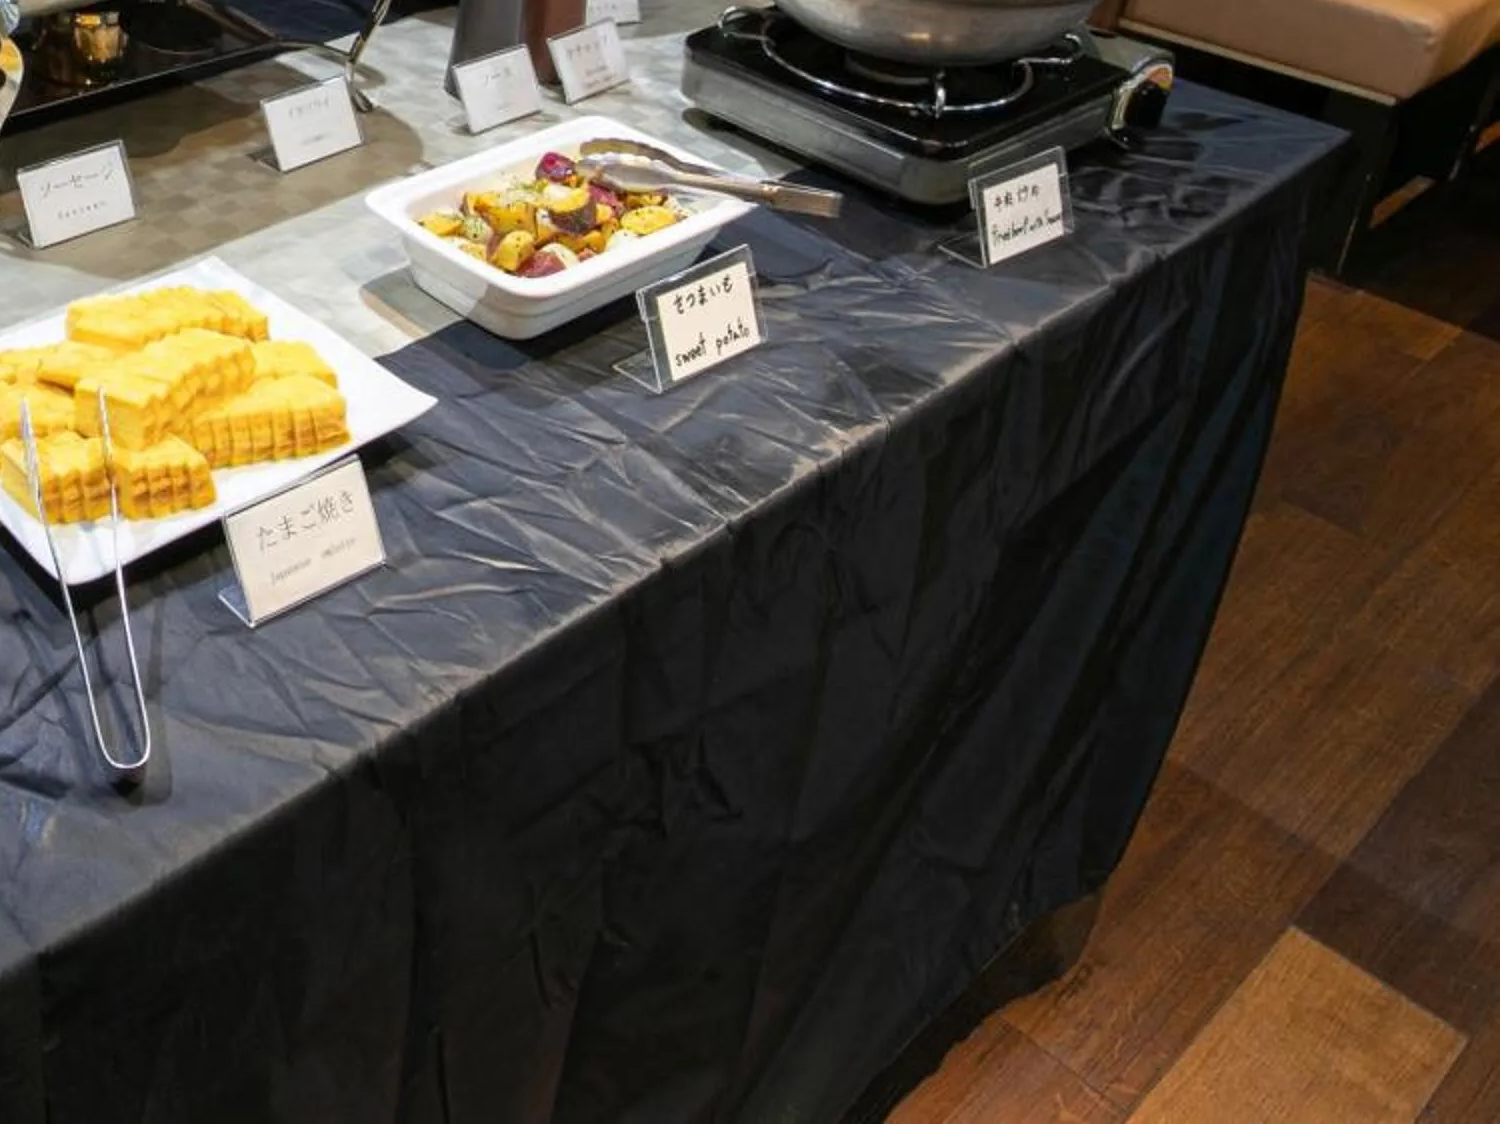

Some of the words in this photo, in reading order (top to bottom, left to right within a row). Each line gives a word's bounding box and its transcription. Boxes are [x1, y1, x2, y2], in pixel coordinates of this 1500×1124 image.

[256, 489, 354, 552] たまご焼き
